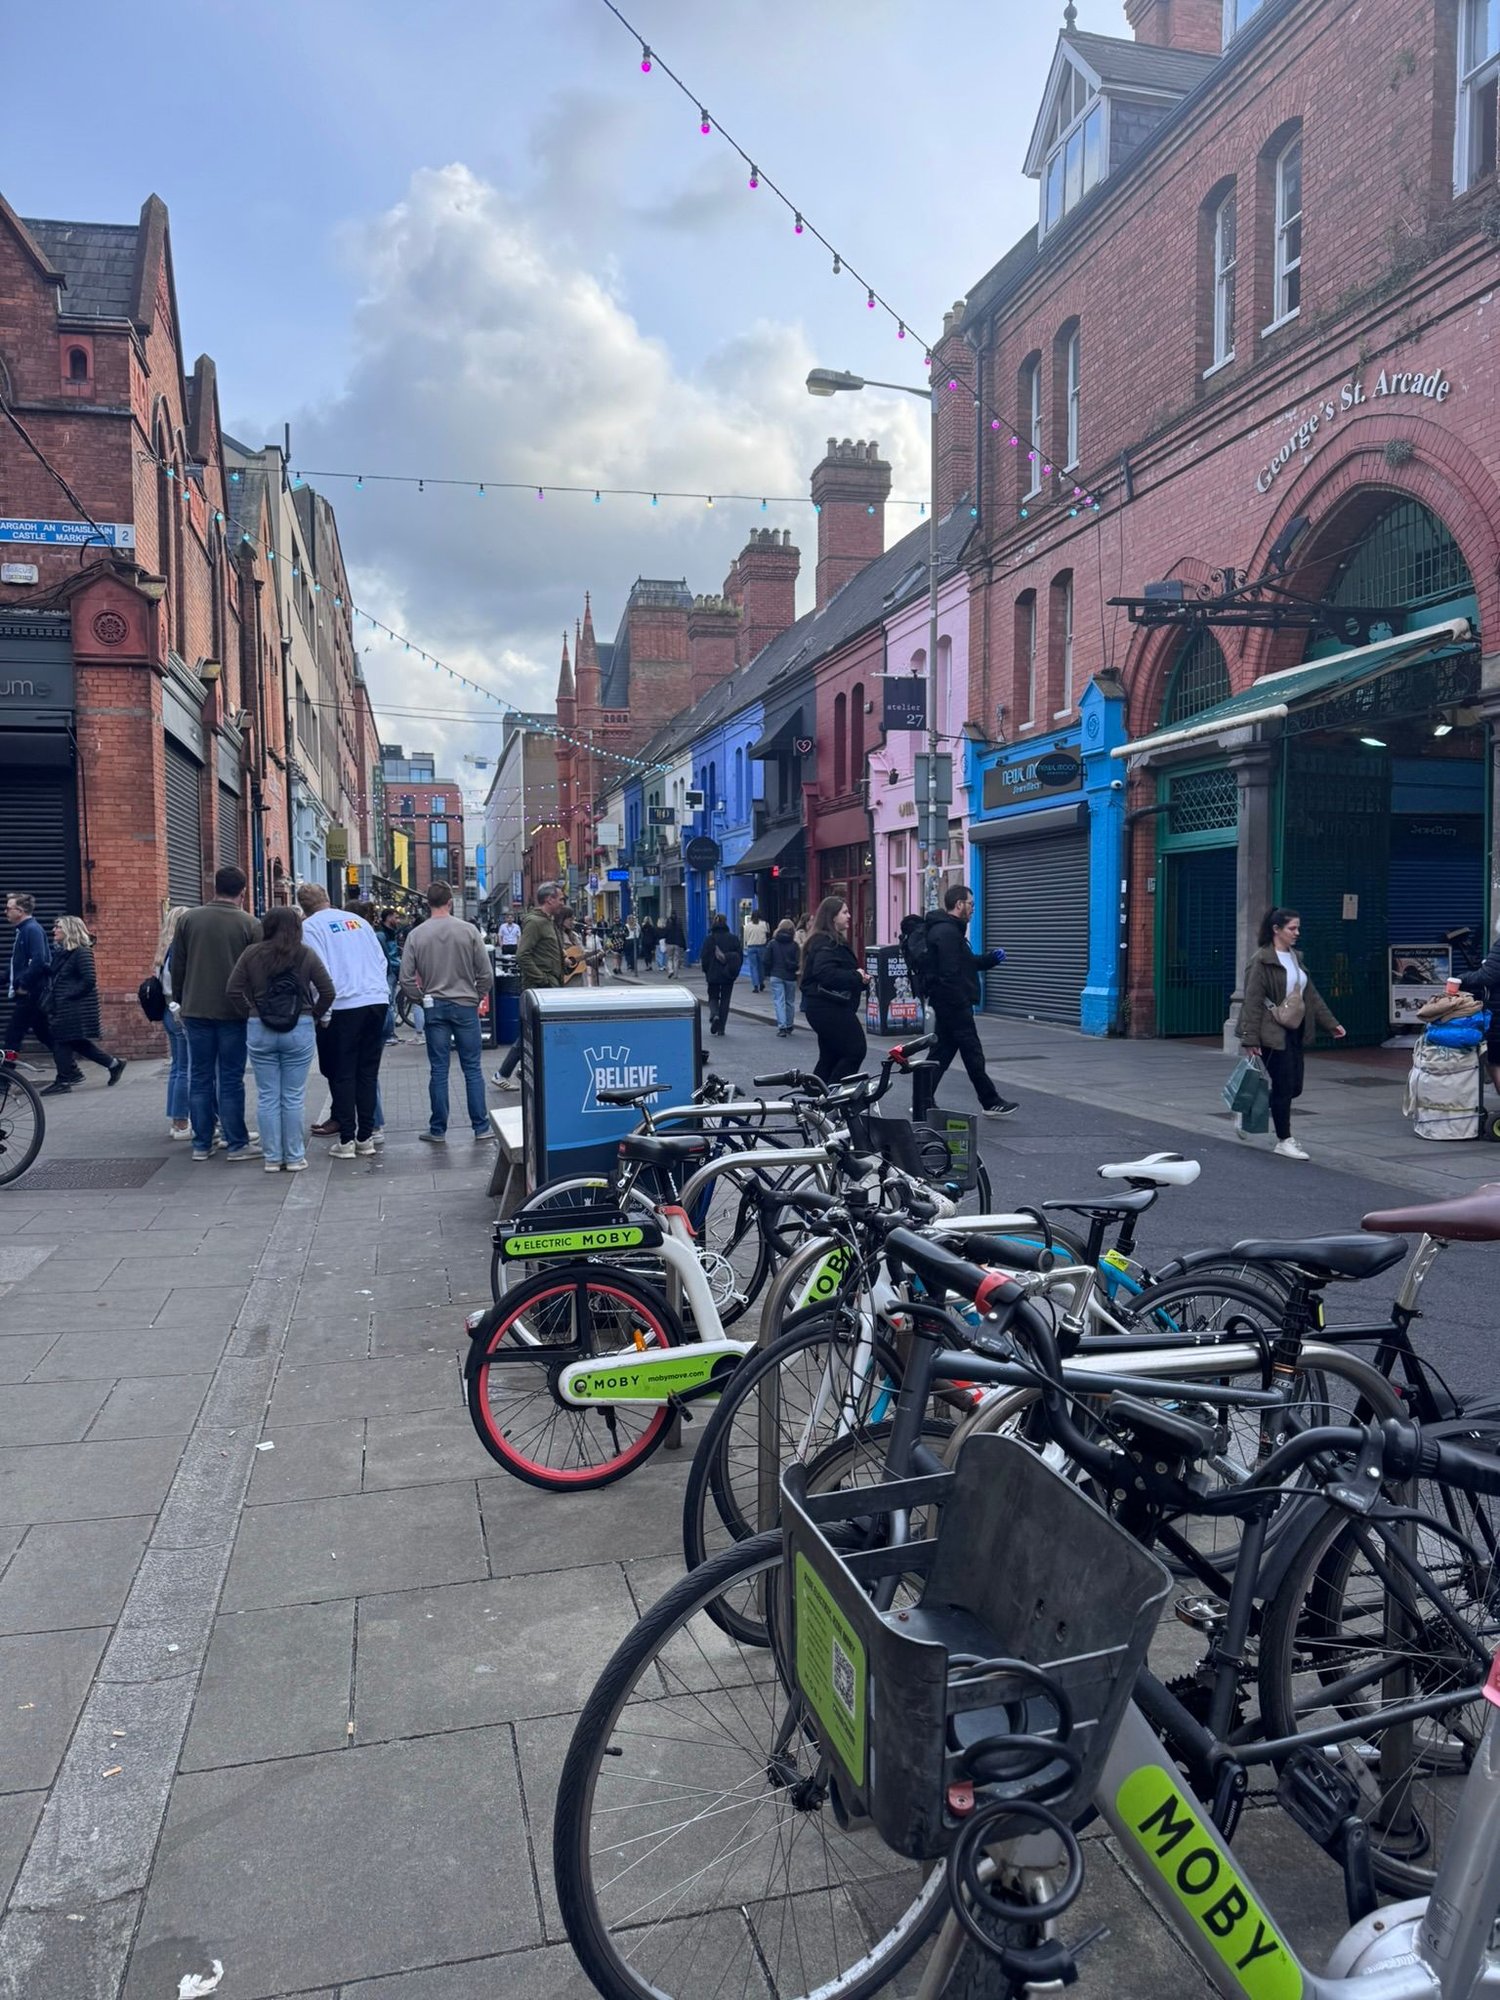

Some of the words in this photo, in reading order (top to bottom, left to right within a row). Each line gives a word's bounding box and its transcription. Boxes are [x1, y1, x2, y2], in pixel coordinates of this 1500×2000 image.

[1256, 400, 1335, 493] George's
[1340, 382, 1366, 412] St.
[1371, 368, 1450, 403] Arcade
[0, 522, 37, 531] ARGADH
[43, 524, 56, 532] AN
[12, 532, 46, 540] CASTLE
[121, 530, 129, 541] 2
[887, 703, 920, 711] atelier
[906, 713, 924, 727] 27
[595, 1065, 658, 1089] BELIEVE
[524, 1237, 572, 1250] ELECTRIC
[582, 1231, 632, 1246] MOBY
[594, 1375, 640, 1390] MOBY
[648, 1370, 704, 1383] mobymove.com
[1137, 1792, 1280, 1972] MOBY
